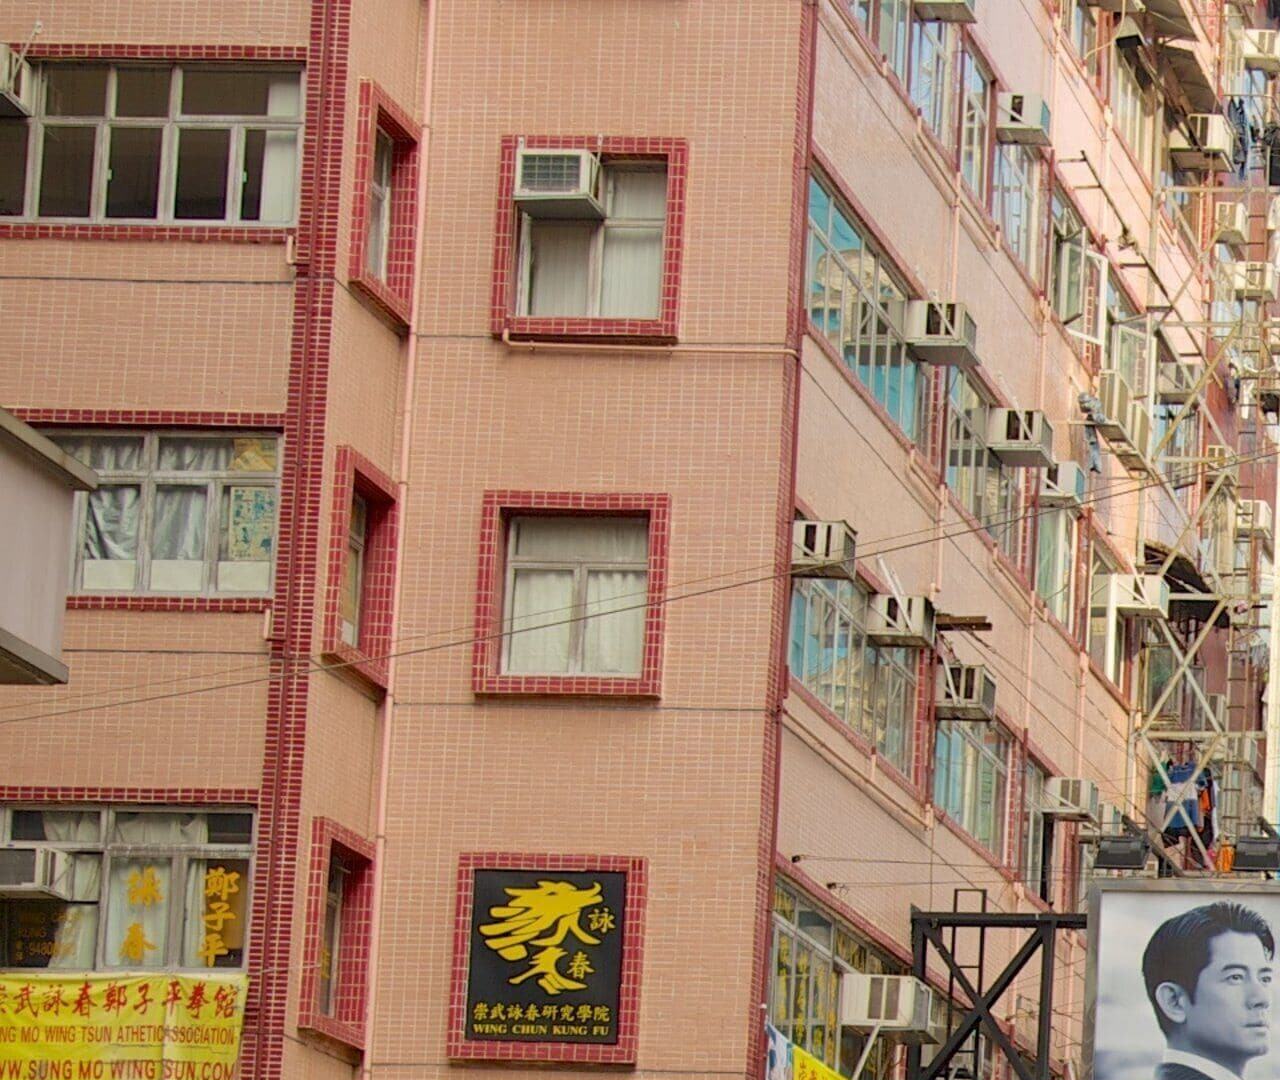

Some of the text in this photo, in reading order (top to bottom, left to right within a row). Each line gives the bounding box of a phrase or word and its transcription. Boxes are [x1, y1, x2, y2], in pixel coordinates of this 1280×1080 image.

[21, 1026, 40, 1042] MO
[45, 1026, 76, 1043] WING
[81, 1027, 111, 1043] TSUN
[473, 1023, 609, 1036] WING CHUN KUNG FU
[79, 1062, 104, 1080] MO
[111, 1062, 156, 1080] WING
